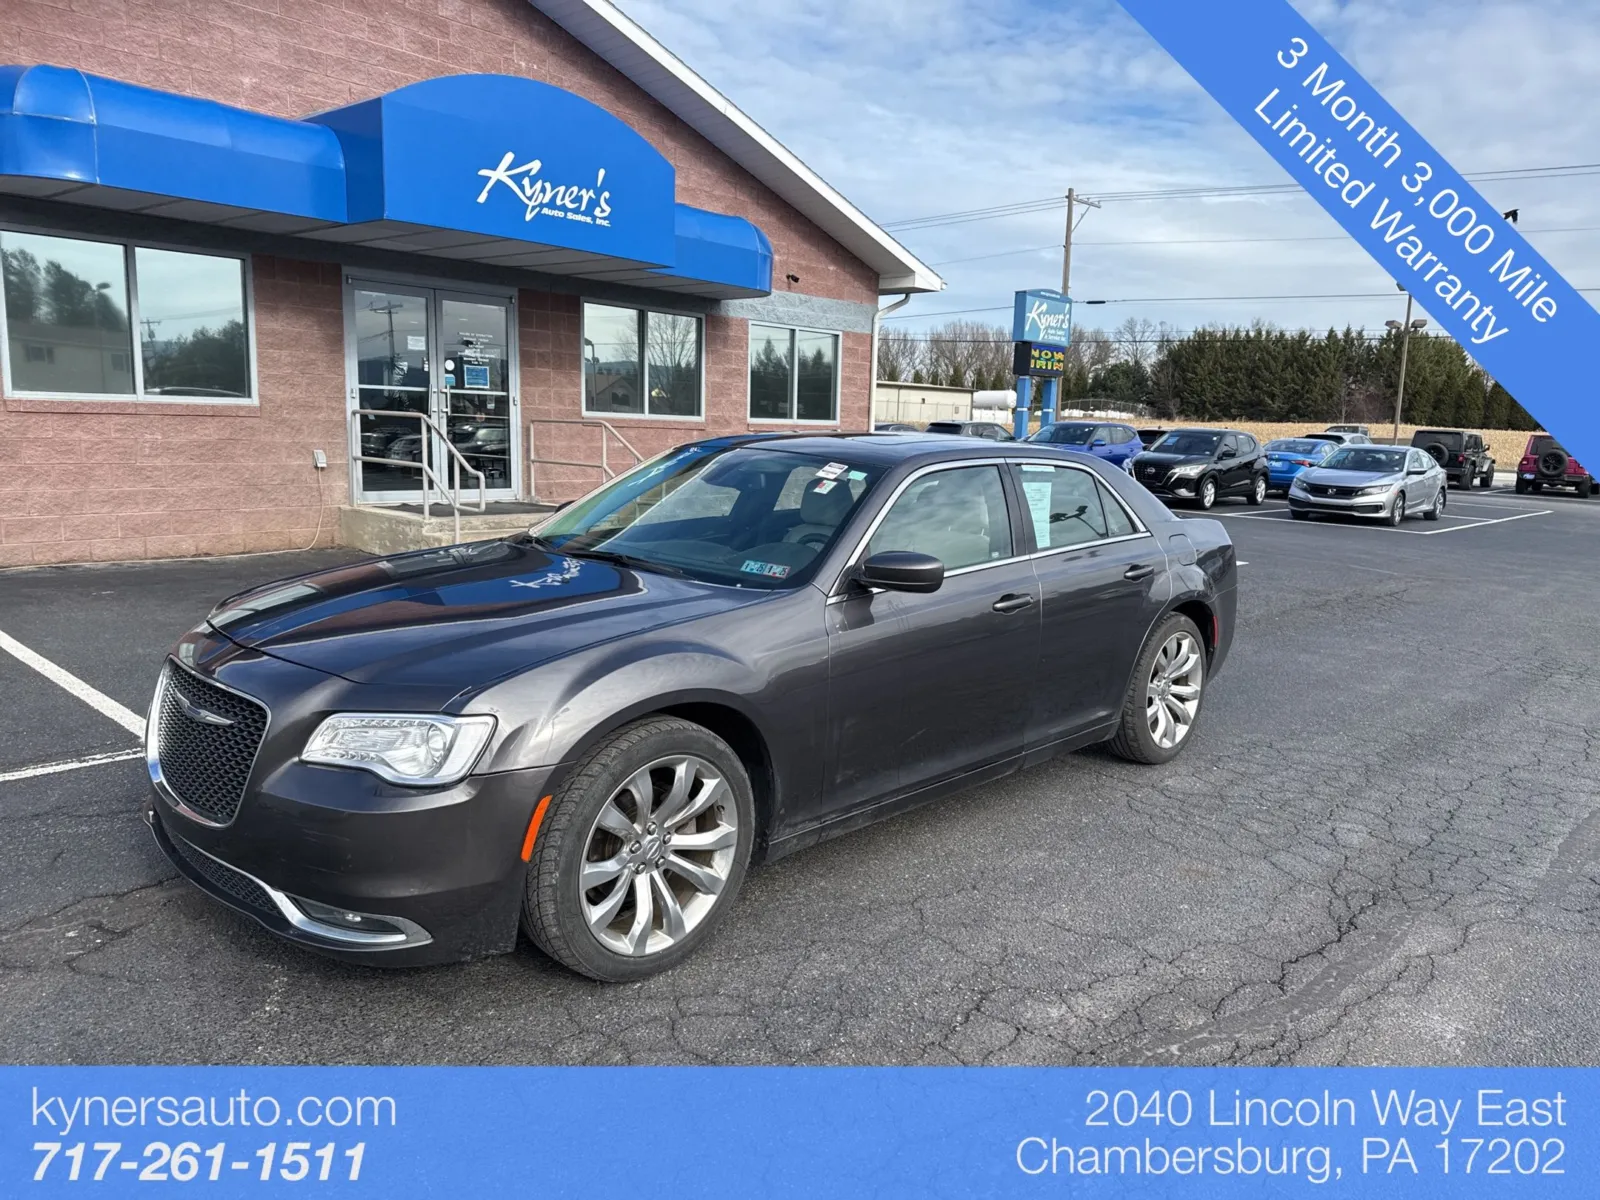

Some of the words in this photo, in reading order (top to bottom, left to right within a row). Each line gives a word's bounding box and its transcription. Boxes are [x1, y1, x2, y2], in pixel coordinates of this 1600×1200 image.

[476, 151, 612, 222] Kyner's
[541, 207, 565, 218] Auto
[1025, 300, 1070, 341] Kyner's
[1031, 348, 1065, 360] NOW
